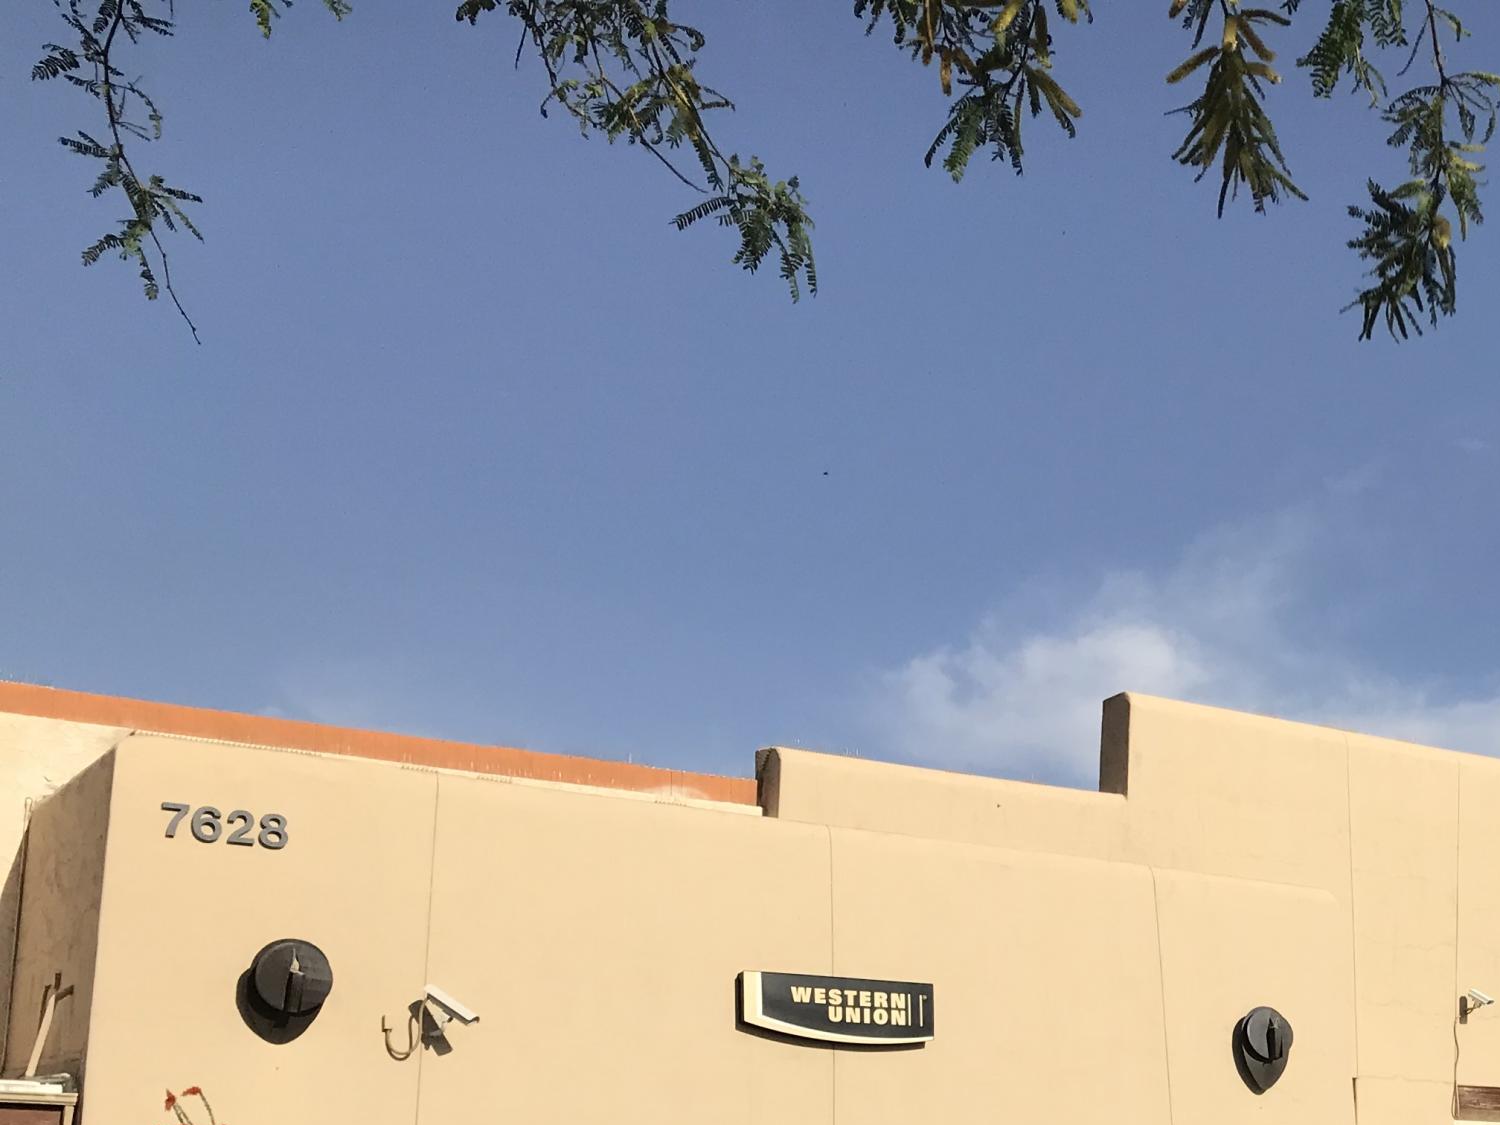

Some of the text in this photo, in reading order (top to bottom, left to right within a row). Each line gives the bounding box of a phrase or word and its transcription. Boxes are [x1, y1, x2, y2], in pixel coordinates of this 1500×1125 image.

[160, 801, 289, 850] 7628
[790, 985, 907, 1009] WESTERN
[827, 1005, 907, 1026] UNION
